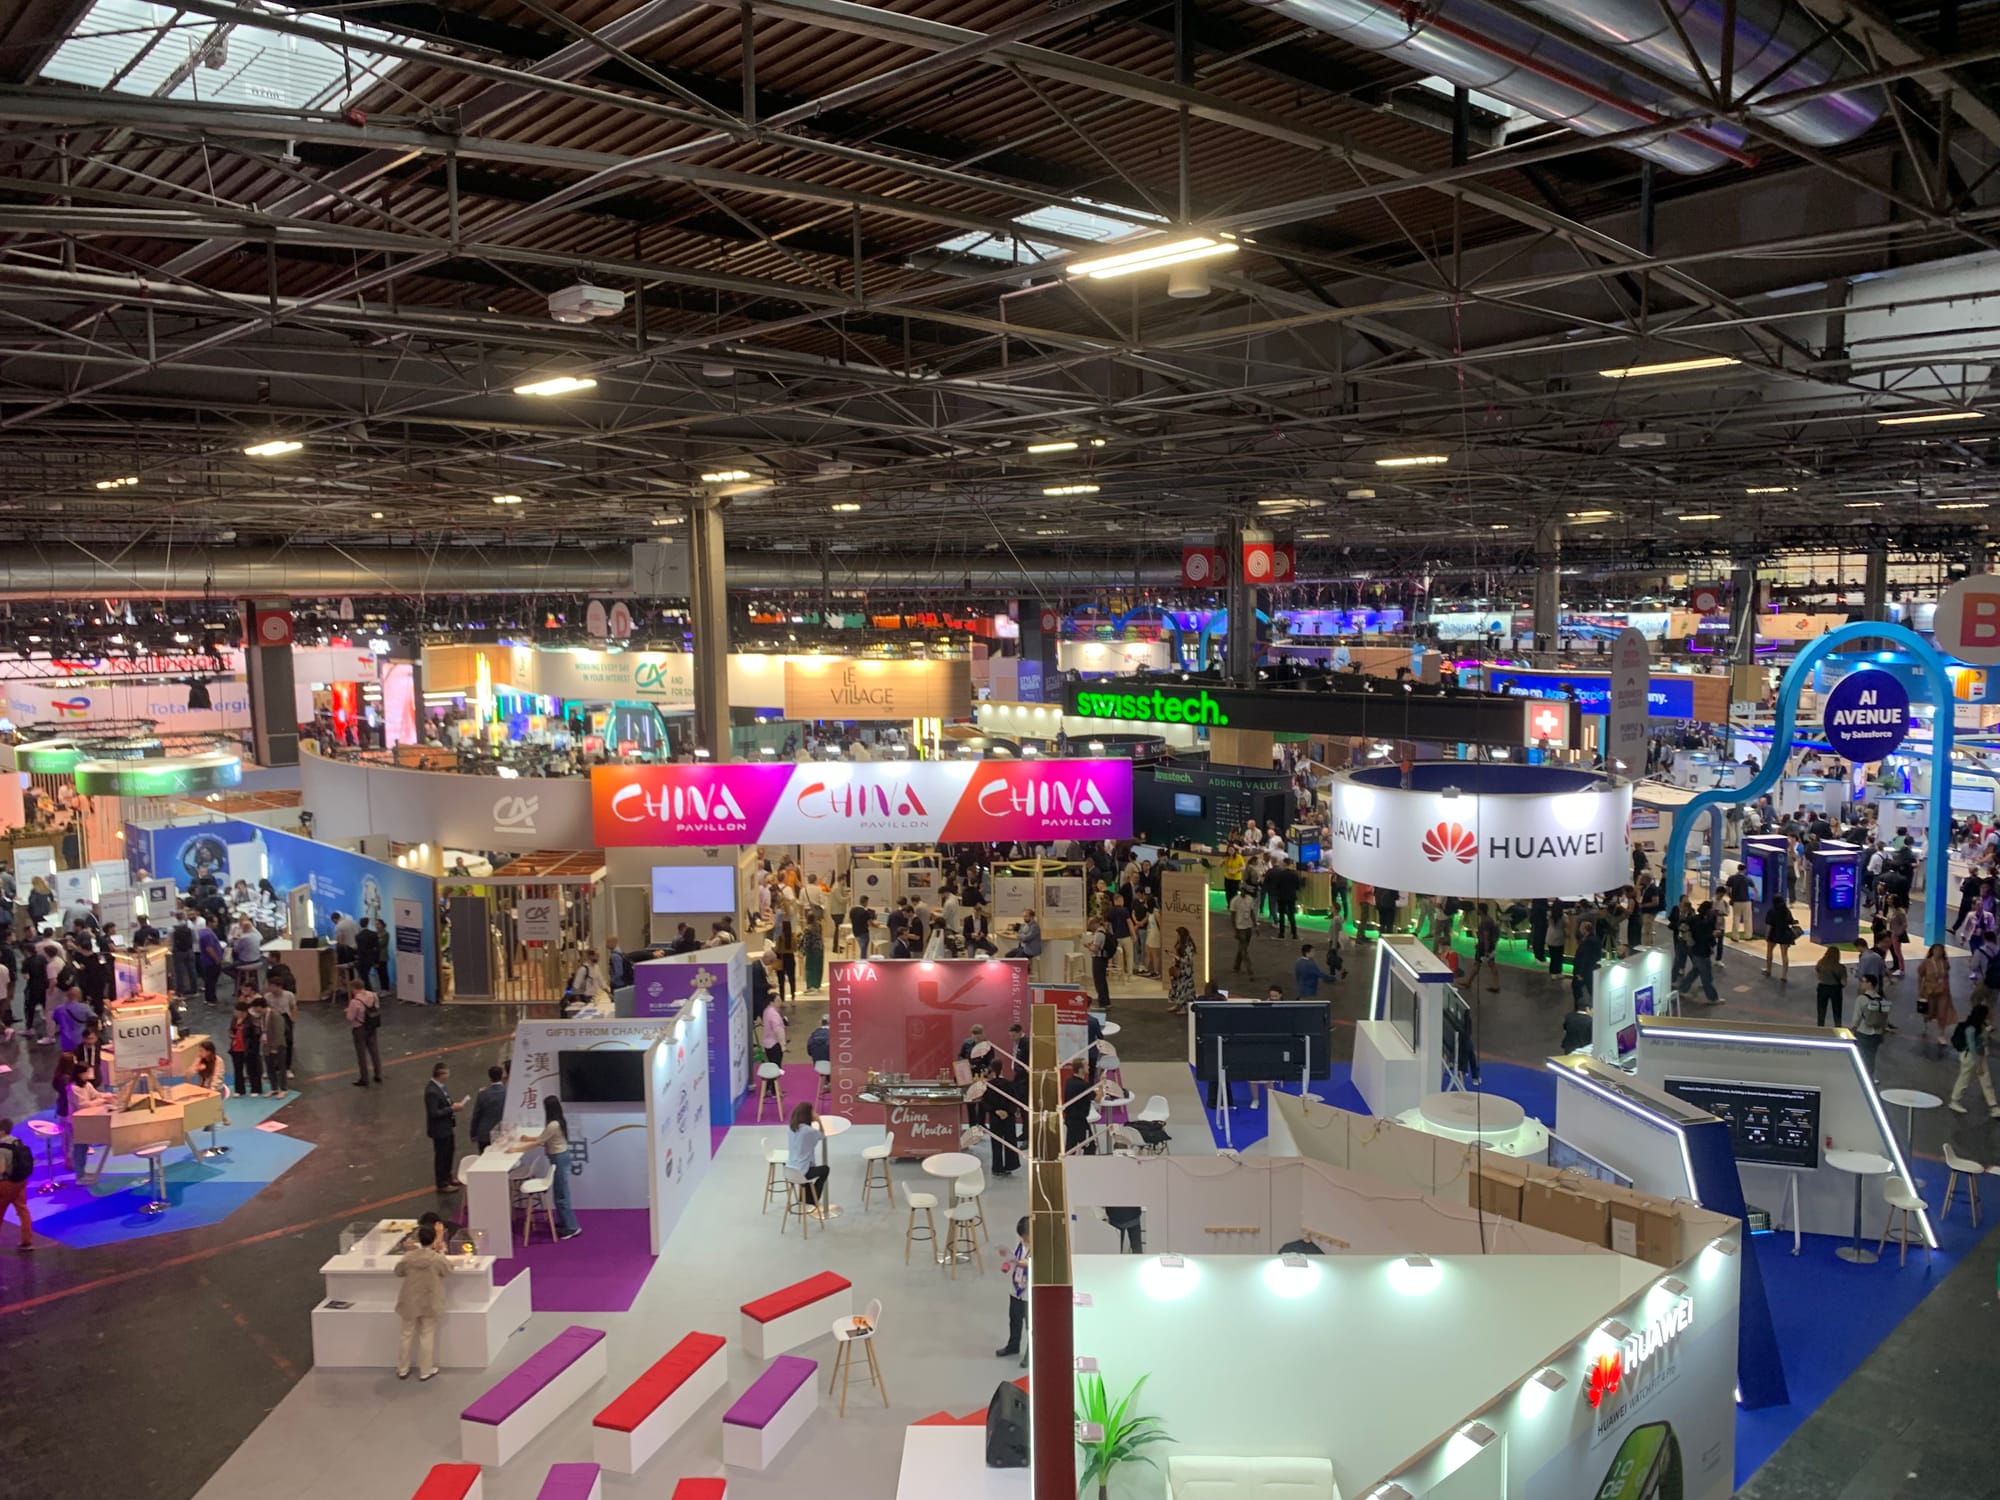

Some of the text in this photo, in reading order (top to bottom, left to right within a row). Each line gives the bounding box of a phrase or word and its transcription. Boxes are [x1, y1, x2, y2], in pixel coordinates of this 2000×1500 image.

[1960, 592, 2000, 648] B
[843, 666, 856, 687] LE
[830, 684, 894, 705] VILLAGE
[1859, 690, 1877, 706] AI
[150, 699, 250, 714] Totaergi
[1077, 689, 1229, 726] swisstech.
[1833, 709, 1902, 726] AVENUE
[1841, 730, 1893, 740] by Salesforce
[1208, 778, 1282, 791] ADDING VALUE.
[612, 782, 746, 823] CHINA
[797, 781, 928, 819] CHINA
[978, 778, 1112, 817] CHINA
[676, 823, 747, 832] PAVILLON
[860, 820, 929, 829] PAVILLON
[1041, 818, 1112, 827] PAVILLON
[1490, 831, 1603, 859] HUAWEI
[1164, 901, 1202, 914] VILLAGE
[834, 967, 878, 982] VIVA
[1012, 999, 1021, 1024] Fran
[118, 1024, 161, 1039] LEION
[545, 1028, 576, 1037] GIFTS
[579, 1027, 609, 1037] FROM
[837, 985, 853, 1117] TECHNOLOGY
[520, 1087, 538, 1110] 唐
[891, 1106, 929, 1124] China
[911, 1122, 953, 1138] Moutai
[1624, 1296, 1694, 1375] HUAWEI
[1597, 1403, 1628, 1436] HUAWEI
[1613, 1459, 1635, 1478] 10
